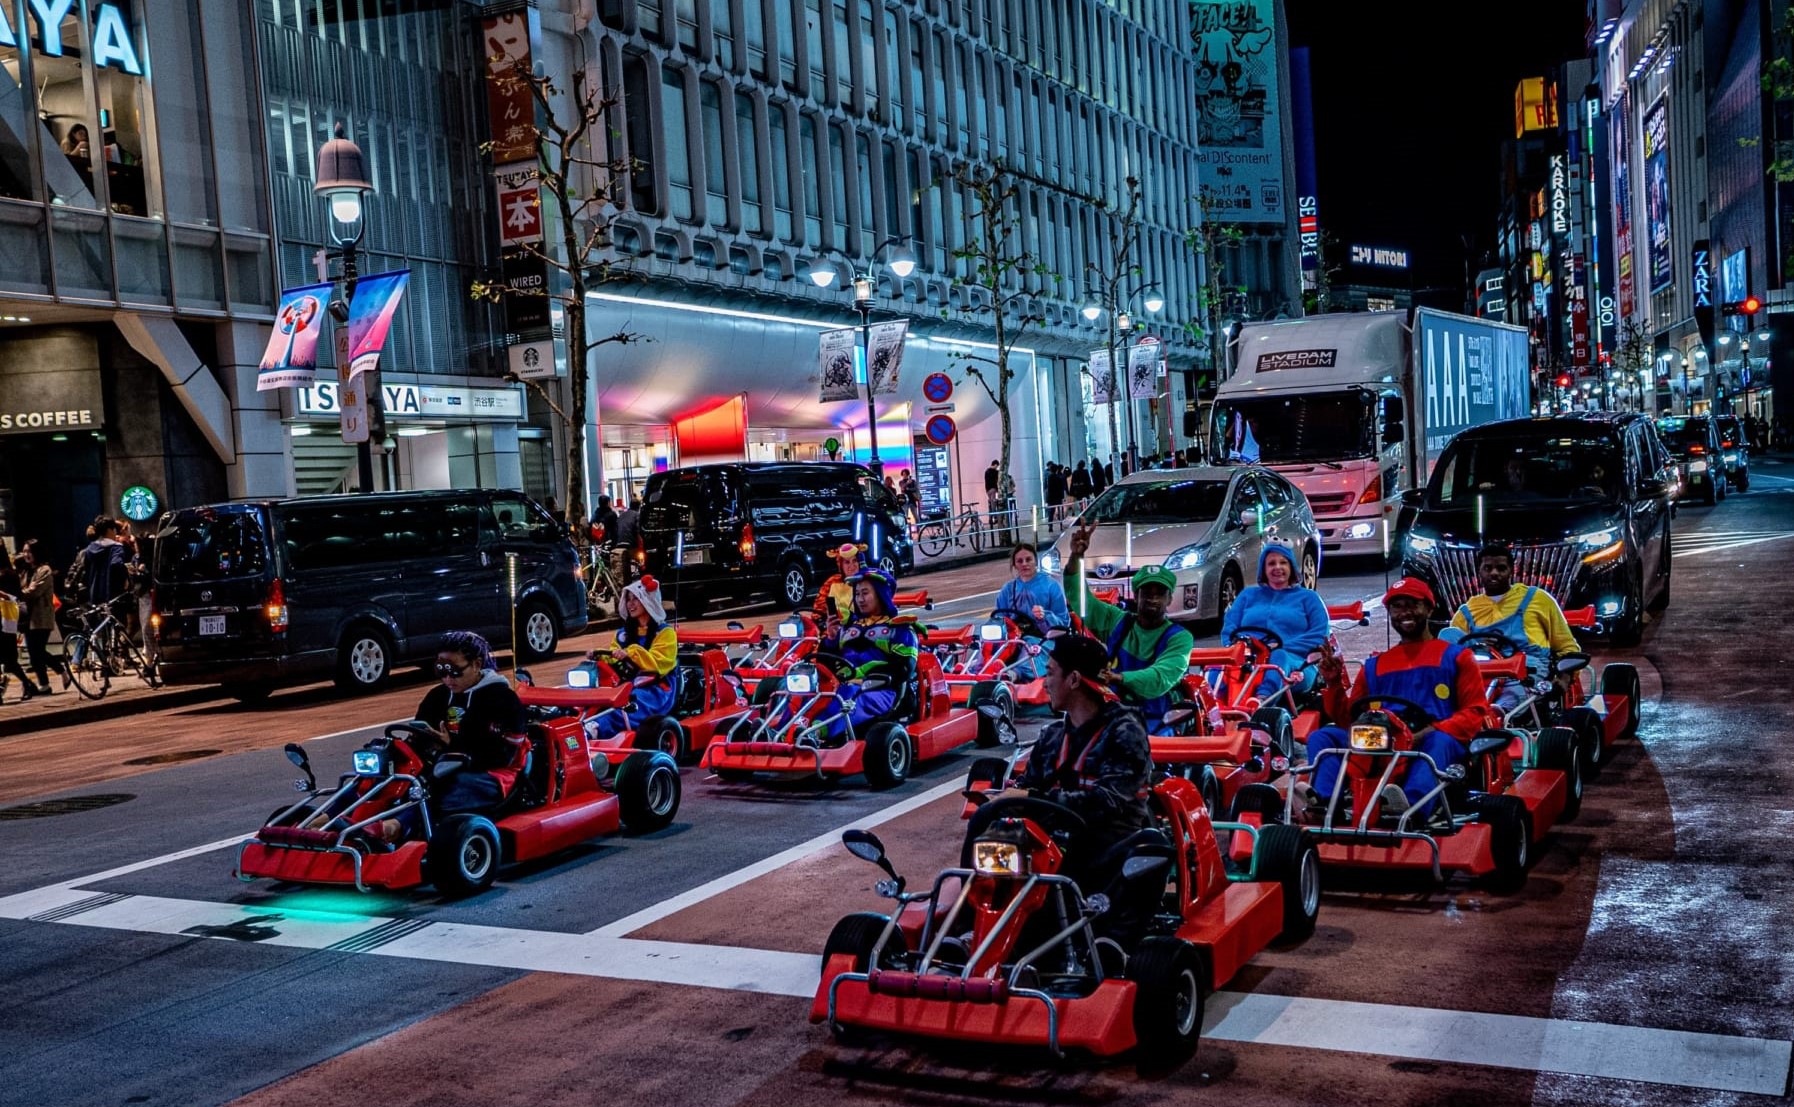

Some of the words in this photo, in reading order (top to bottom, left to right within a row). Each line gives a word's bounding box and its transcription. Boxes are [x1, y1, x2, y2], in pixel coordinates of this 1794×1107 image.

[1551, 154, 1566, 232] KARAOKE
[505, 196, 536, 232] 本
[510, 274, 542, 289] WIRED
[1694, 251, 1711, 307] ZARA
[1260, 358, 1331, 370] STADIUM
[1261, 351, 1333, 363] LIVEDAM
[1426, 329, 1470, 428] AAA
[299, 385, 419, 413] TSYA
[15, 410, 92, 428] COFFEE
